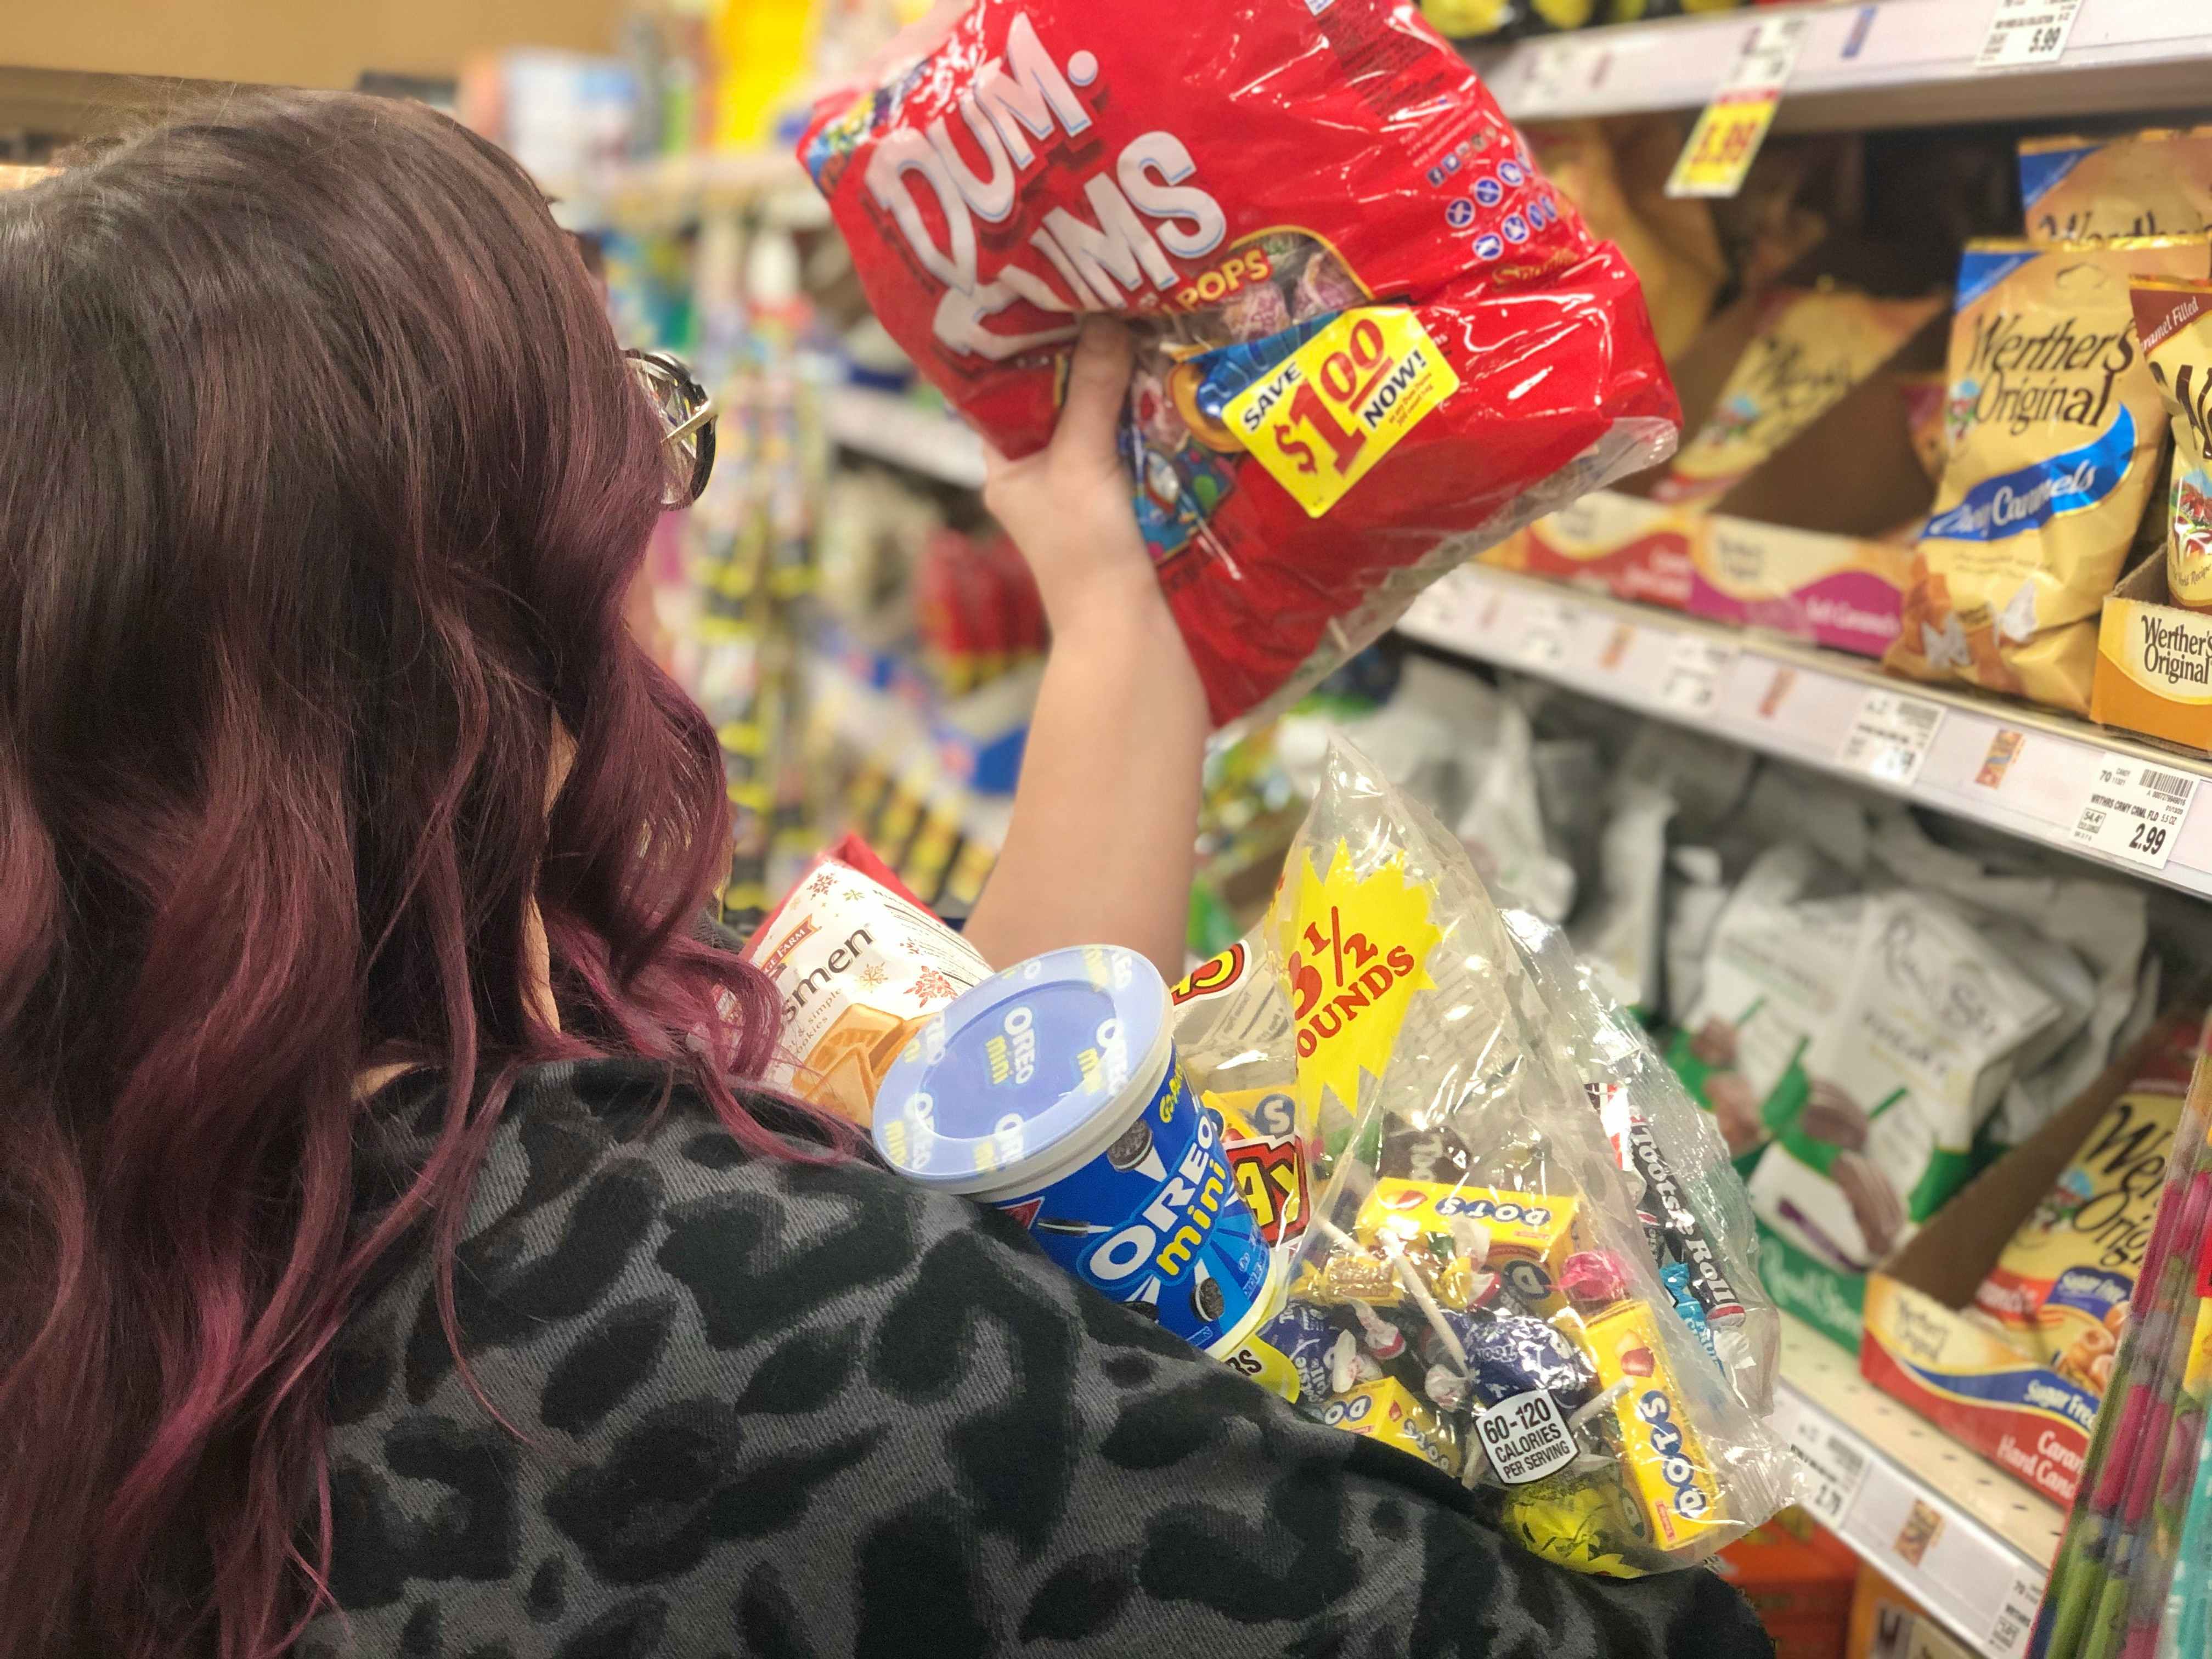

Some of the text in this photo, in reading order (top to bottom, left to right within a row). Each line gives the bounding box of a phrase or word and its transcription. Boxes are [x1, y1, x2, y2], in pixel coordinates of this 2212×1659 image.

[1177, 249, 1269, 305] POPS
[2140, 296, 2199, 352] ramel Filled
[1244, 361, 1302, 432] SAVE
[1363, 349, 1427, 430] NOW!
[1975, 370, 2115, 437] Original
[2144, 643, 2210, 684] Original
[2100, 770, 2112, 783] 70
[2128, 823, 2166, 855] 2.99
[777, 928, 806, 958] FARM
[781, 929, 873, 1024] smen
[1296, 945, 1414, 1058] OUNDS
[807, 988, 842, 1024] simple
[796, 1017, 828, 1054] ookies
[985, 1035, 1013, 1085] mini
[1004, 1006, 1036, 1085] OREO
[1090, 1115, 1214, 1280] OREO
[1156, 1160, 1227, 1277] mini
[1437, 1197, 1550, 1227] DOTS
[1630, 1125, 1735, 1303] Tootsie Roll
[1483, 1397, 1551, 1444] 60-120
[2024, 1379, 2070, 1409] Sugar
[1494, 1423, 1561, 1463] CALORIES
[1503, 1440, 1570, 1479] PER SERVING
[1638, 1391, 1705, 1517] DOTS
